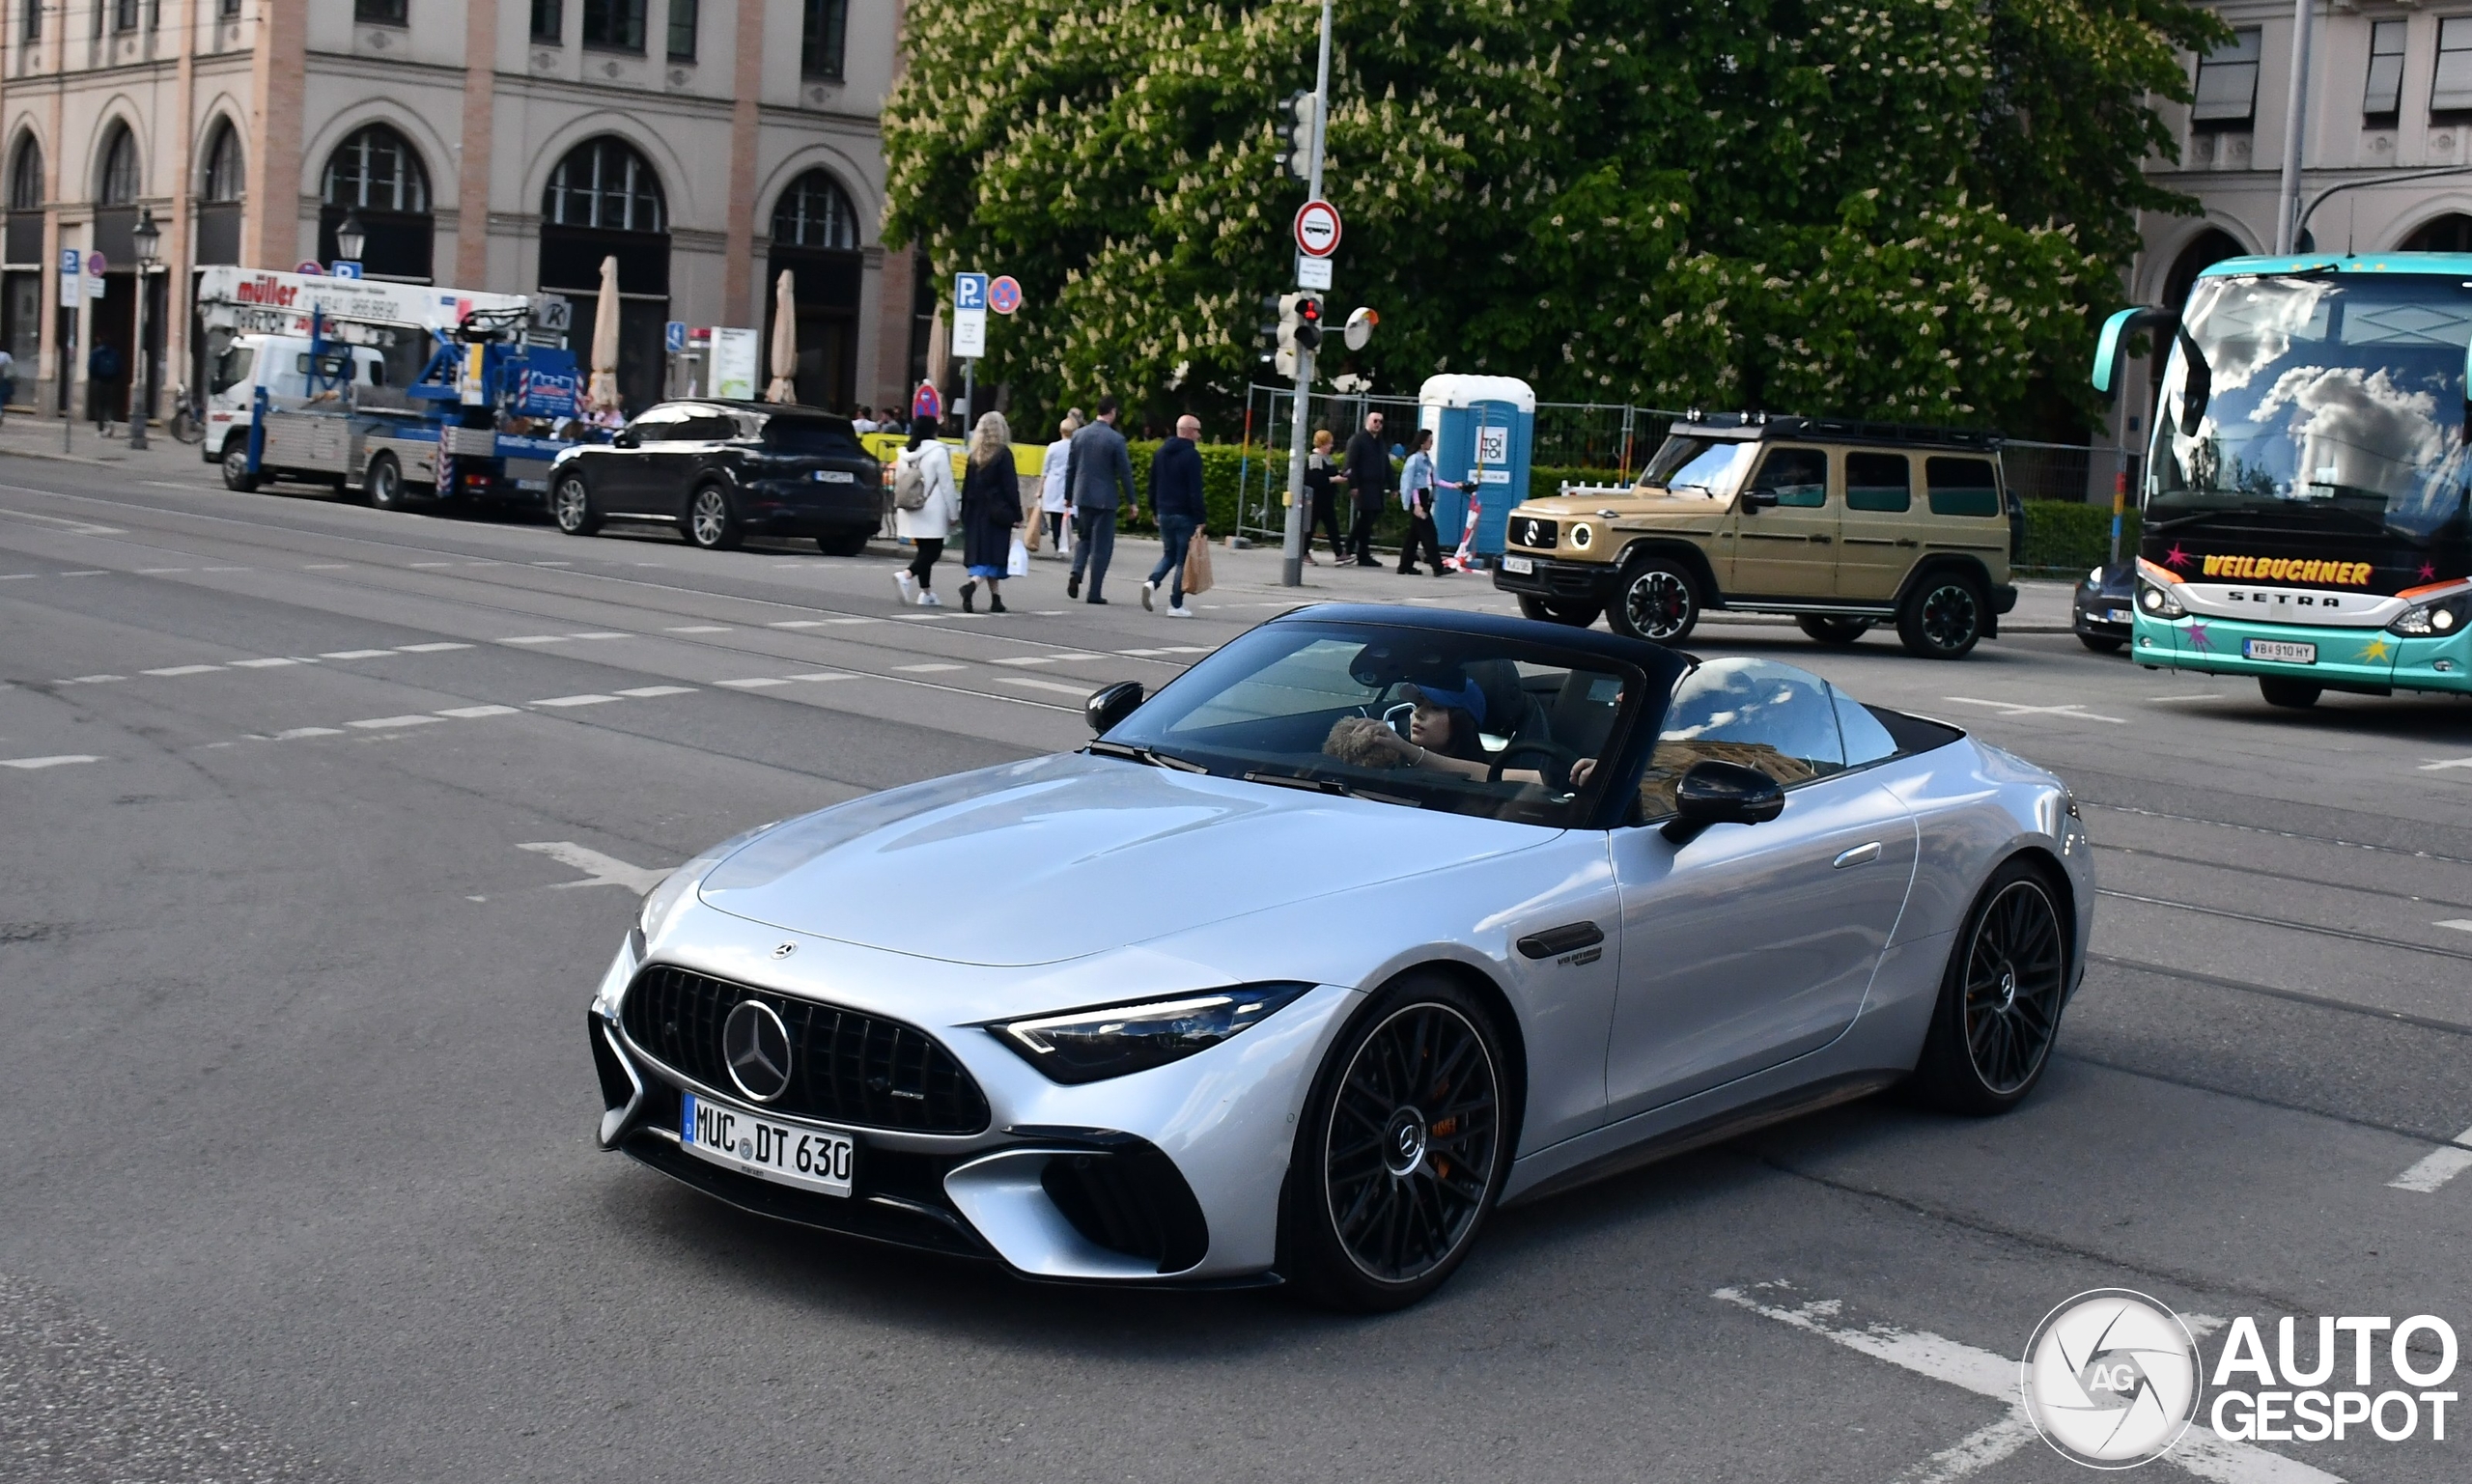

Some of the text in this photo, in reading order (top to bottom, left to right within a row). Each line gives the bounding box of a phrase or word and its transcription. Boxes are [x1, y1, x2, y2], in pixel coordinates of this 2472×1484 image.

[238, 274, 298, 307] müller
[959, 277, 977, 306] P
[2203, 554, 2374, 585] WEILBUCHNER
[2228, 591, 2340, 608] SETRA
[2254, 643, 2310, 658] VB 910 HY
[686, 1123, 692, 1135] D
[696, 1104, 852, 1181] MUC DT 630
